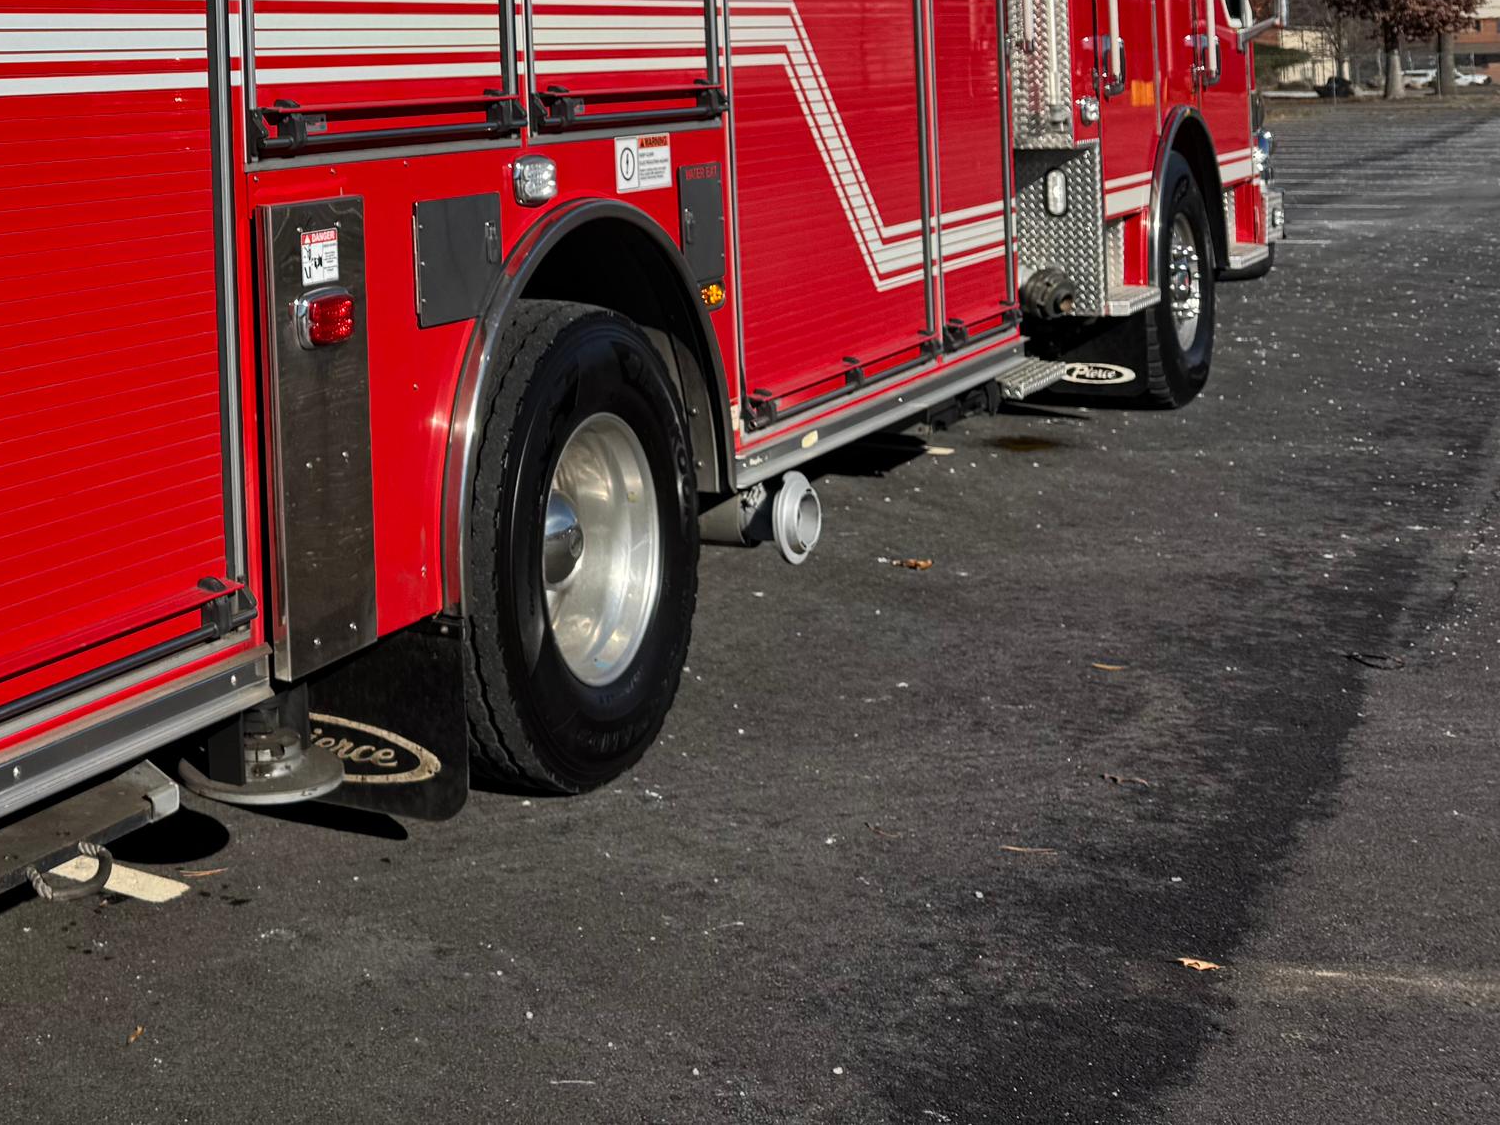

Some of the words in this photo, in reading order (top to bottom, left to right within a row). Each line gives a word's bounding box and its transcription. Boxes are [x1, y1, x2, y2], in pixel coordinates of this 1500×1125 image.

[312, 230, 335, 243] DANGER
[1071, 363, 1116, 380] Pierce
[311, 728, 398, 767] ierce
